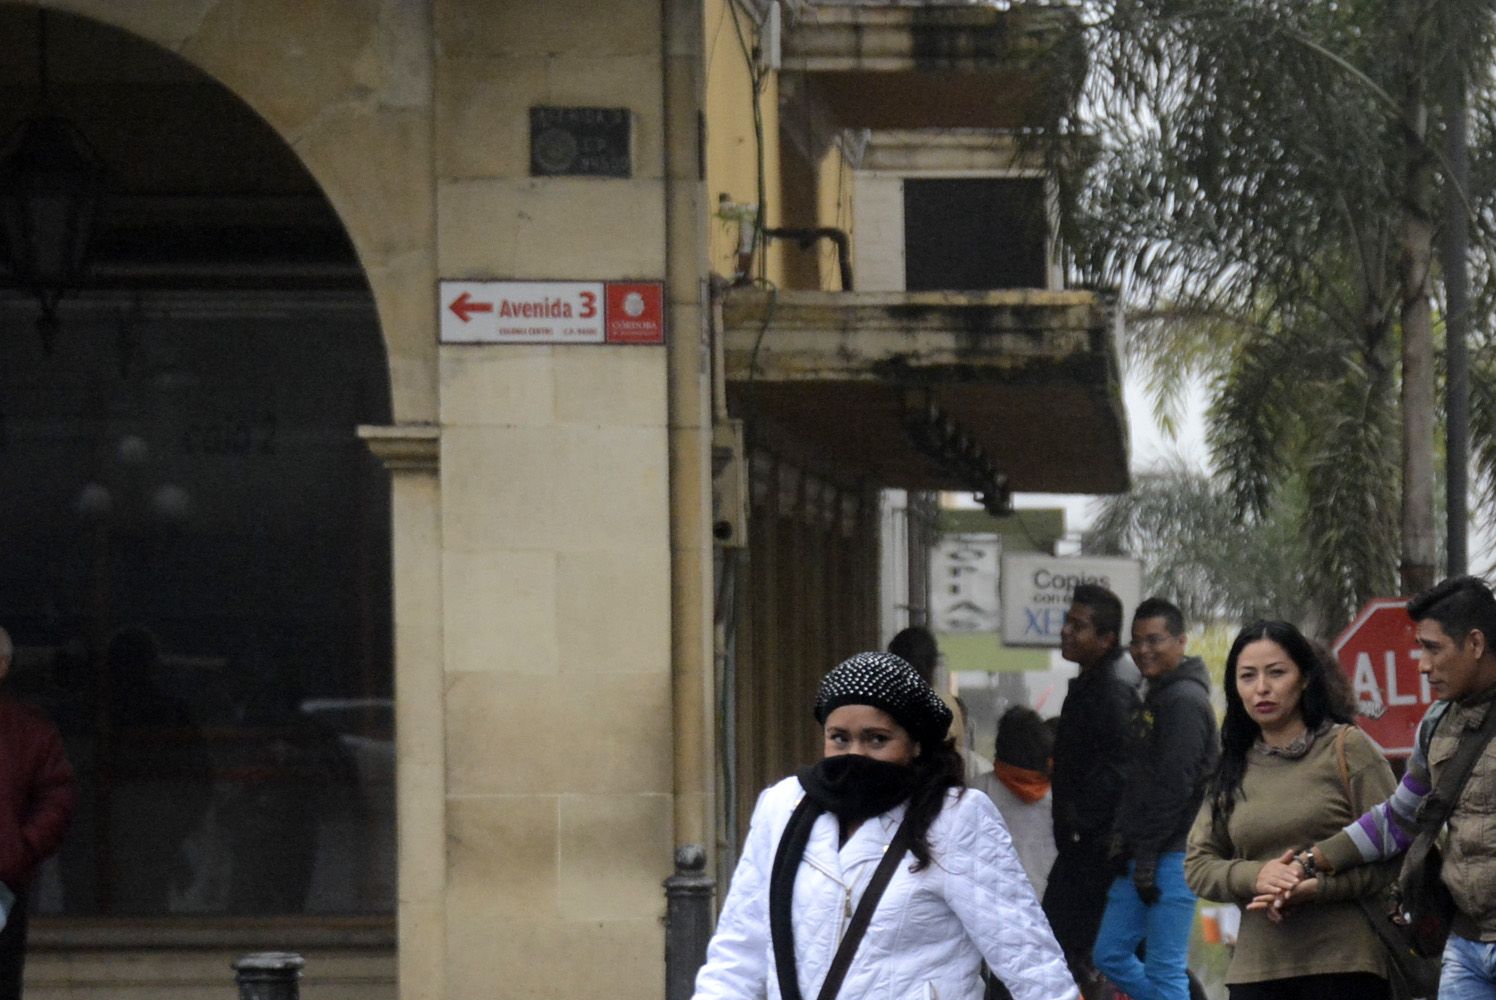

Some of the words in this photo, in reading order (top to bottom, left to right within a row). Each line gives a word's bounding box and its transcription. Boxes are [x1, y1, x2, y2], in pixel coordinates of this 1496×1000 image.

[500, 297, 573, 318] Avenida
[579, 291, 597, 318] 3
[1033, 569, 1111, 591] Copias
[1353, 650, 1432, 706] ALT
